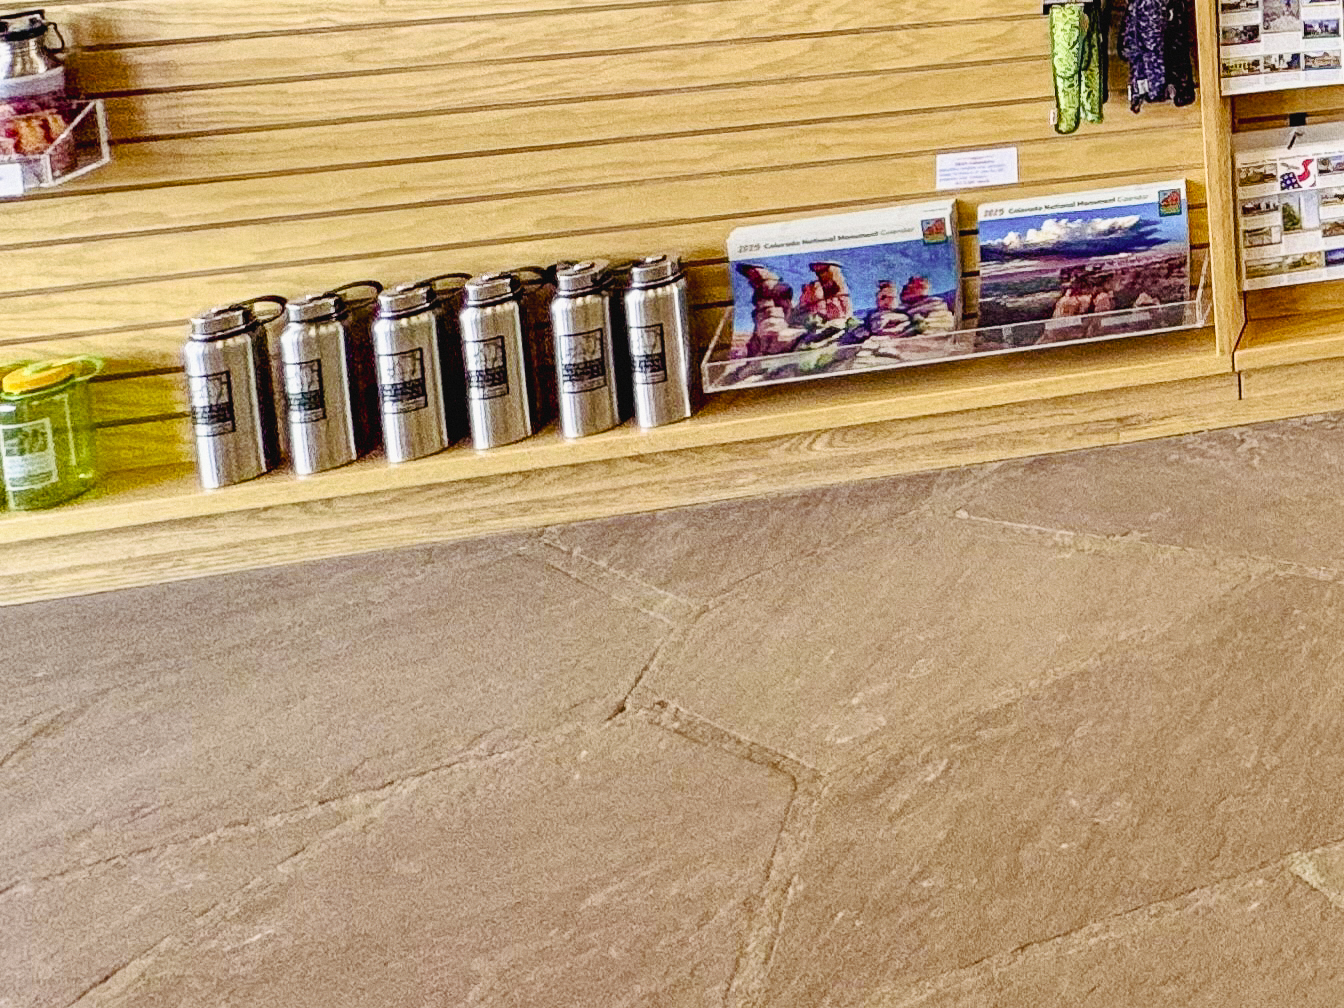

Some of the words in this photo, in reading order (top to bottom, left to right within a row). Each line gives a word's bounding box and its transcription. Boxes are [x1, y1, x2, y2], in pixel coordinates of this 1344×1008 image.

[1008, 206, 1043, 215] Colorado
[1044, 201, 1076, 211] National
[1077, 197, 1116, 207] Monument
[764, 240, 801, 249] Colorado
[802, 235, 836, 245] National
[837, 231, 879, 241] Monument
